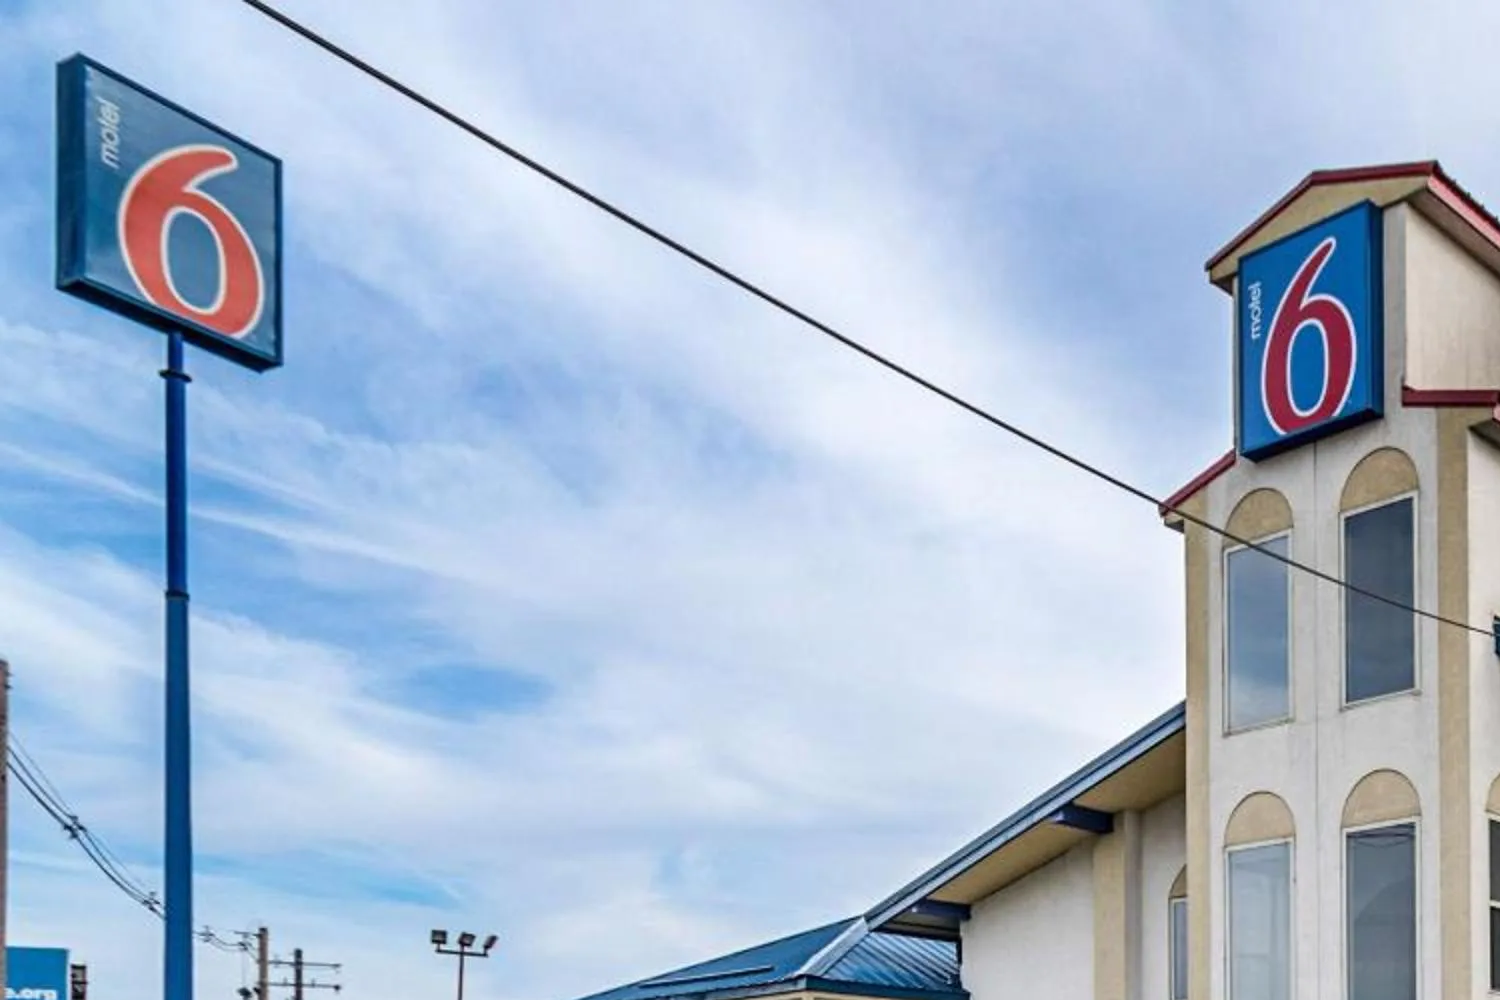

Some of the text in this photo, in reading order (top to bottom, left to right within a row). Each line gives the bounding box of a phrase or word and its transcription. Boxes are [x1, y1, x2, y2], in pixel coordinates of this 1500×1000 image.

[96, 95, 120, 169] motel
[118, 144, 264, 338] 6
[1247, 281, 1262, 339] motel
[1261, 236, 1357, 435] 6
